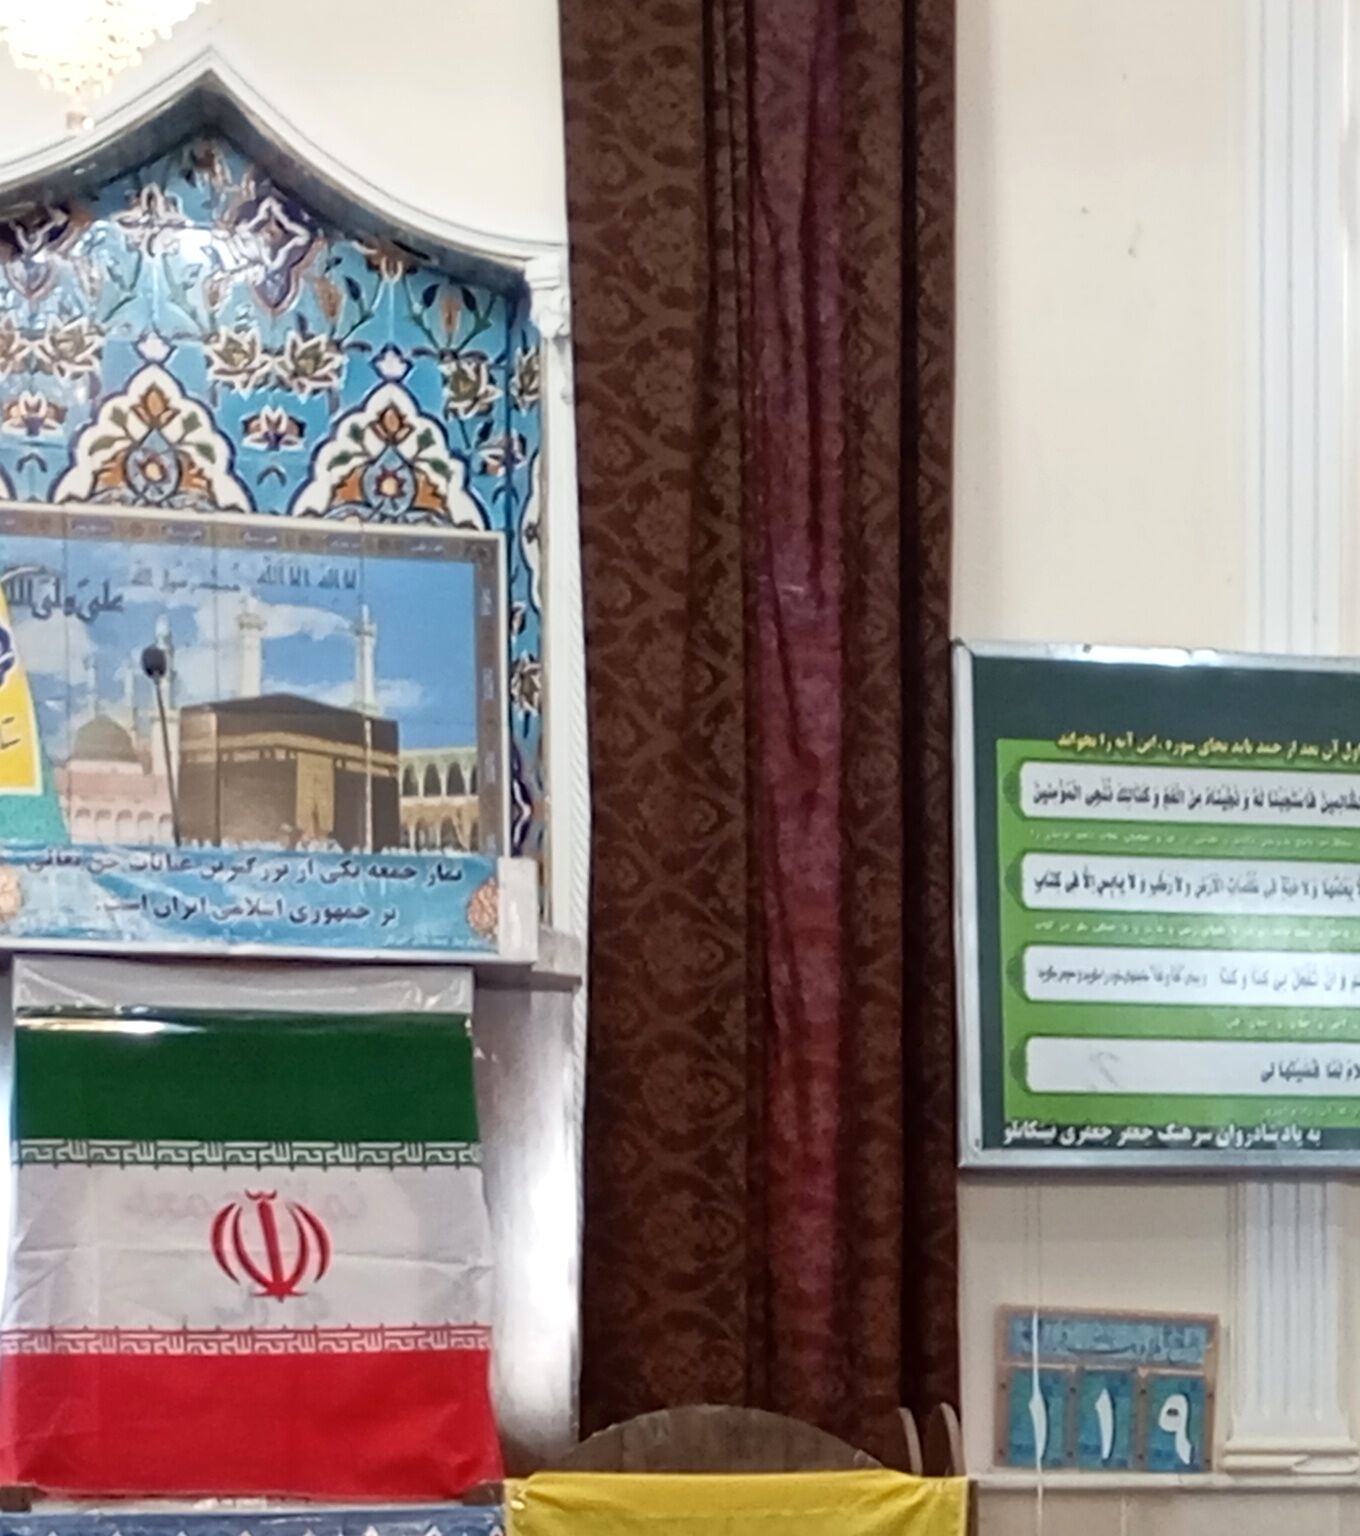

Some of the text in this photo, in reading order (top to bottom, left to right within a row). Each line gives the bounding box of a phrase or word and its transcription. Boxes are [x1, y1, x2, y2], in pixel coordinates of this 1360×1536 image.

[296, 857, 314, 884] از
[152, 895, 207, 921] ایران
[288, 904, 371, 928] جمهوری
[1058, 1125, 1113, 1148] جعفری
[1116, 1126, 1154, 1148] جعفر
